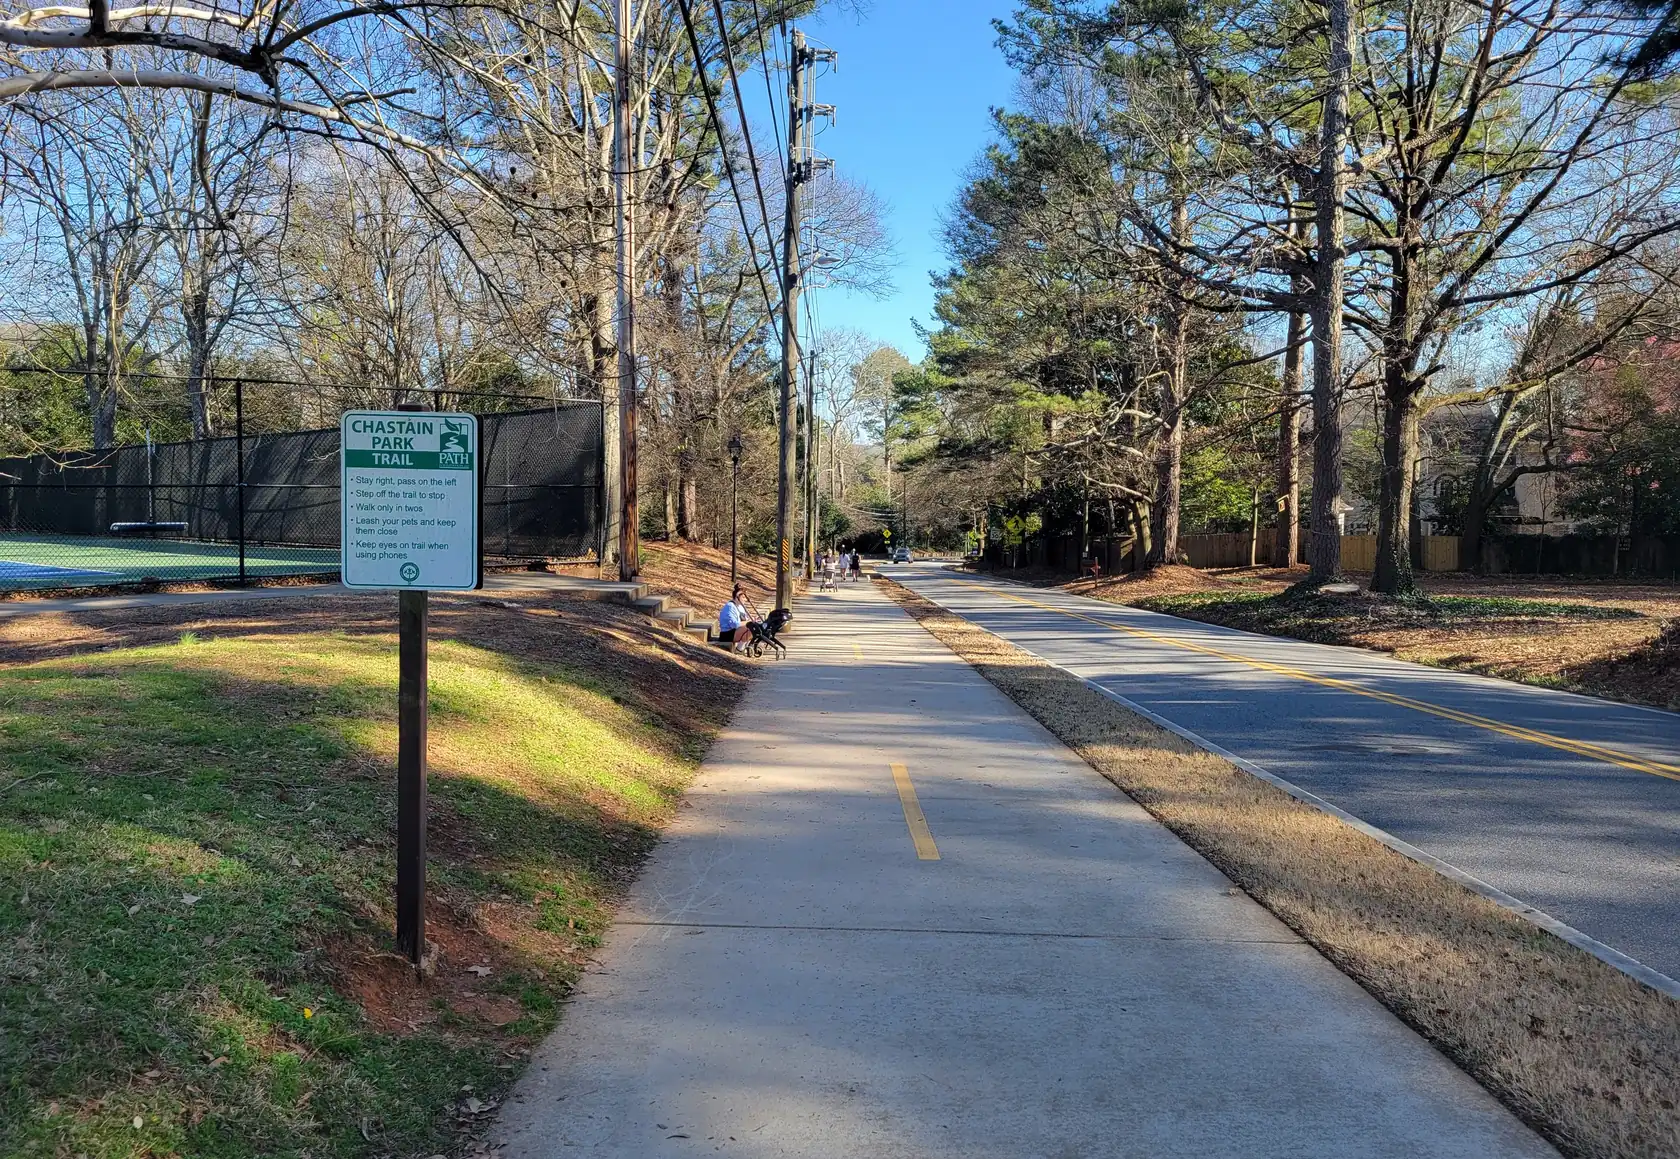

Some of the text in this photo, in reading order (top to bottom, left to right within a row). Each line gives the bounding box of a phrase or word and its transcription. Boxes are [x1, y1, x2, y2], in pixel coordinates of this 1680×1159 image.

[352, 420, 433, 435] CHASTAIN
[372, 437, 414, 449] PARK
[372, 453, 413, 465] TRAIL
[439, 452, 469, 464] PATH
[356, 476, 373, 485] Stay
[376, 477, 395, 486] right,
[430, 478, 443, 486] the
[445, 478, 457, 486] left
[356, 490, 374, 498] Step
[428, 492, 445, 500] stop
[377, 504, 393, 513] only
[402, 519, 418, 527] pets
[437, 519, 456, 527] keep
[356, 541, 376, 550] Keep
[356, 552, 407, 560] using phones
